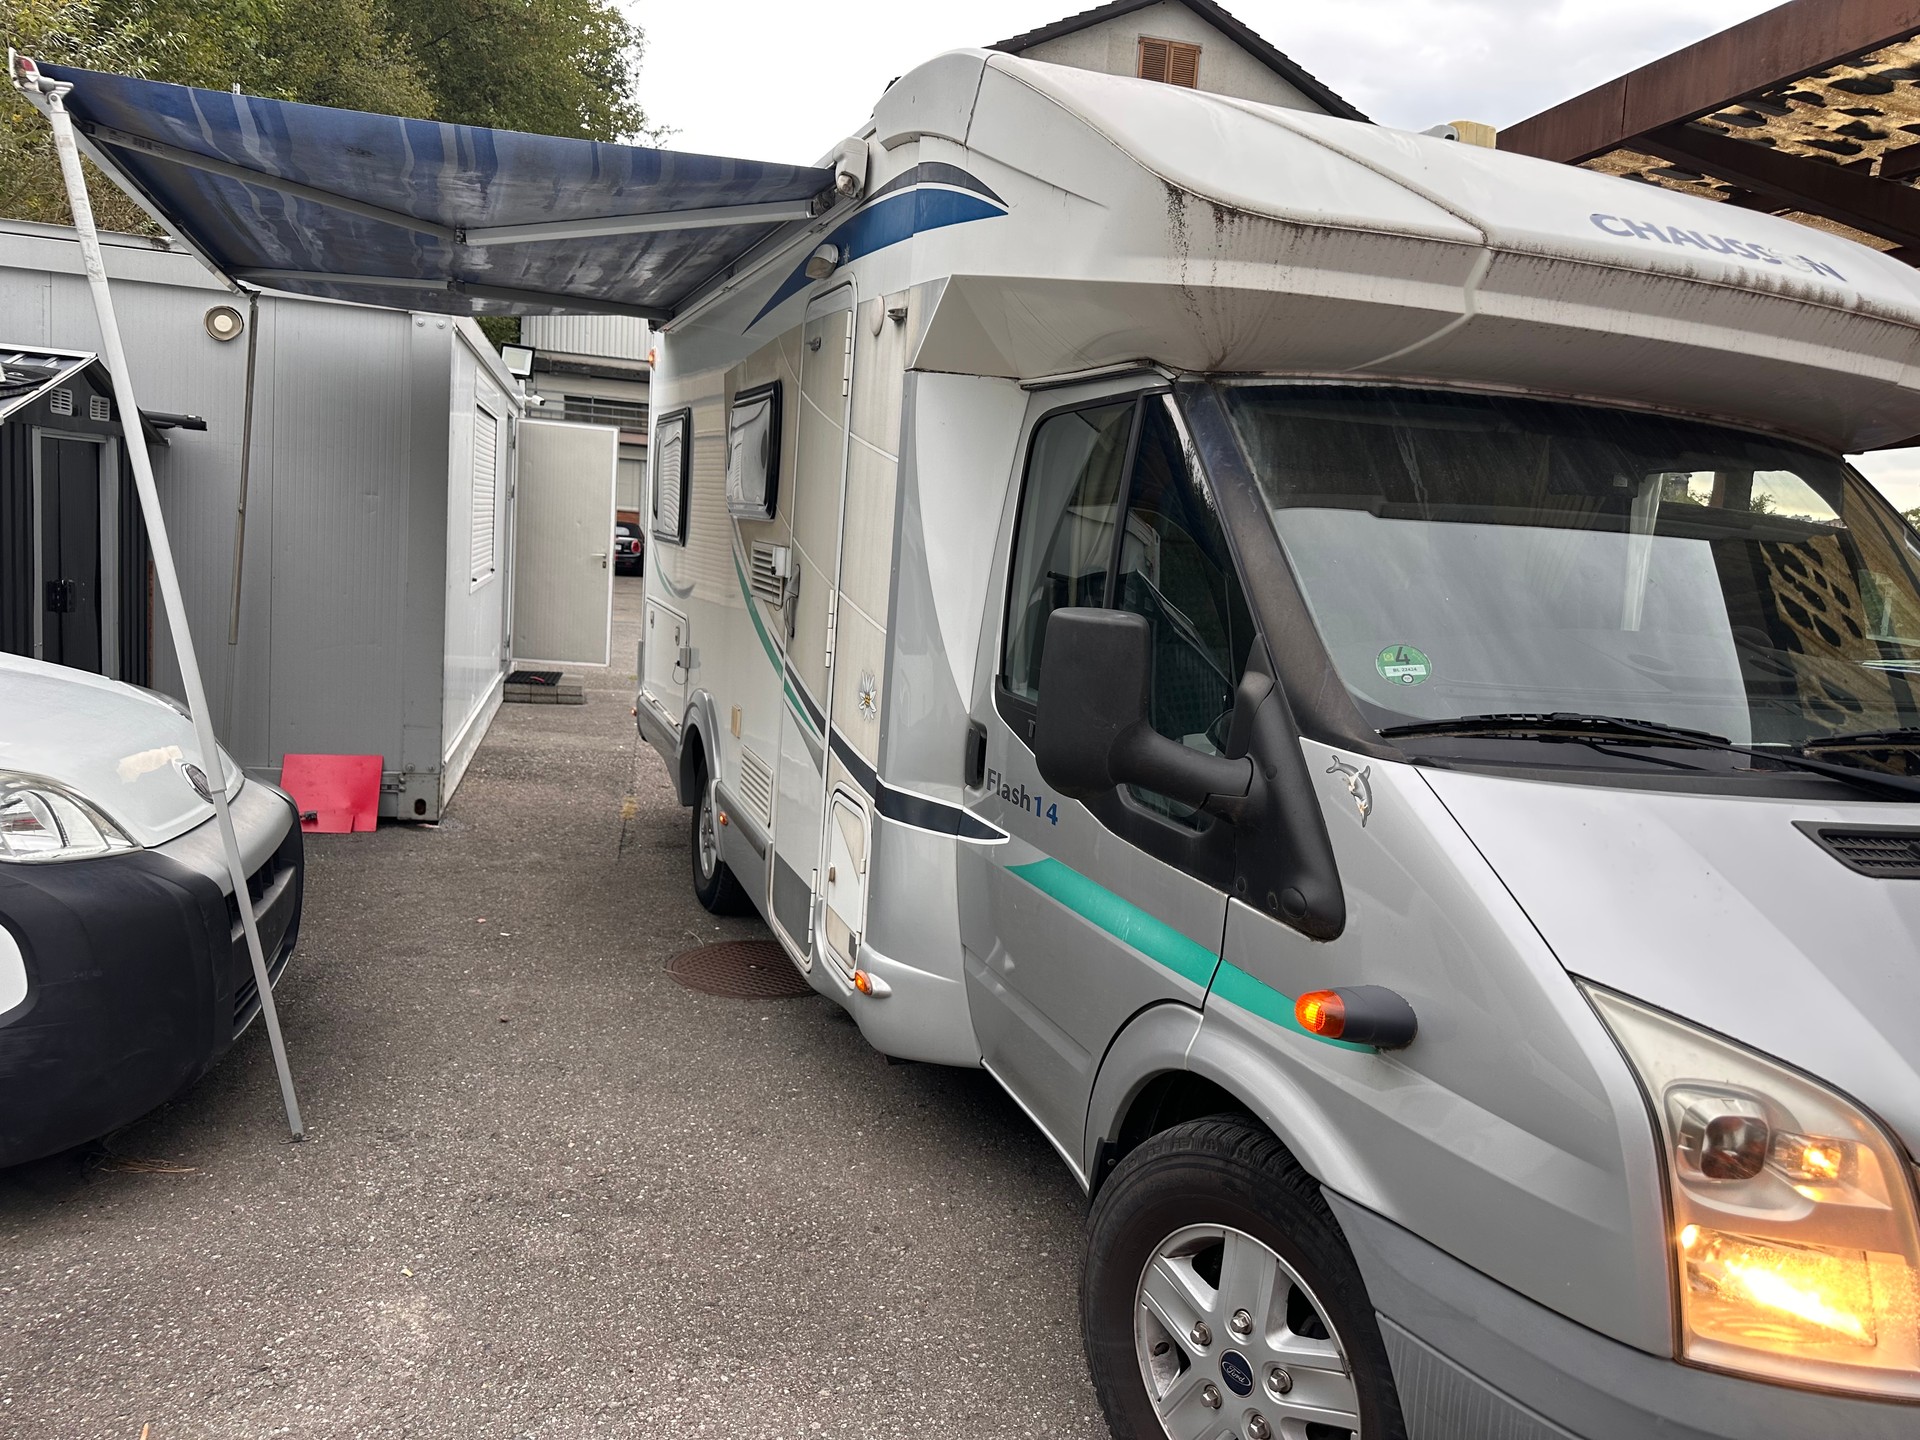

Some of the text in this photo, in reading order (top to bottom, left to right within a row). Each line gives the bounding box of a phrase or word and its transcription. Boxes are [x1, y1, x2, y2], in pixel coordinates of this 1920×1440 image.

[1589, 213, 1847, 282] CHAUSSN
[1395, 646, 1411, 665] 4
[1226, 1365, 1246, 1383] Ford
